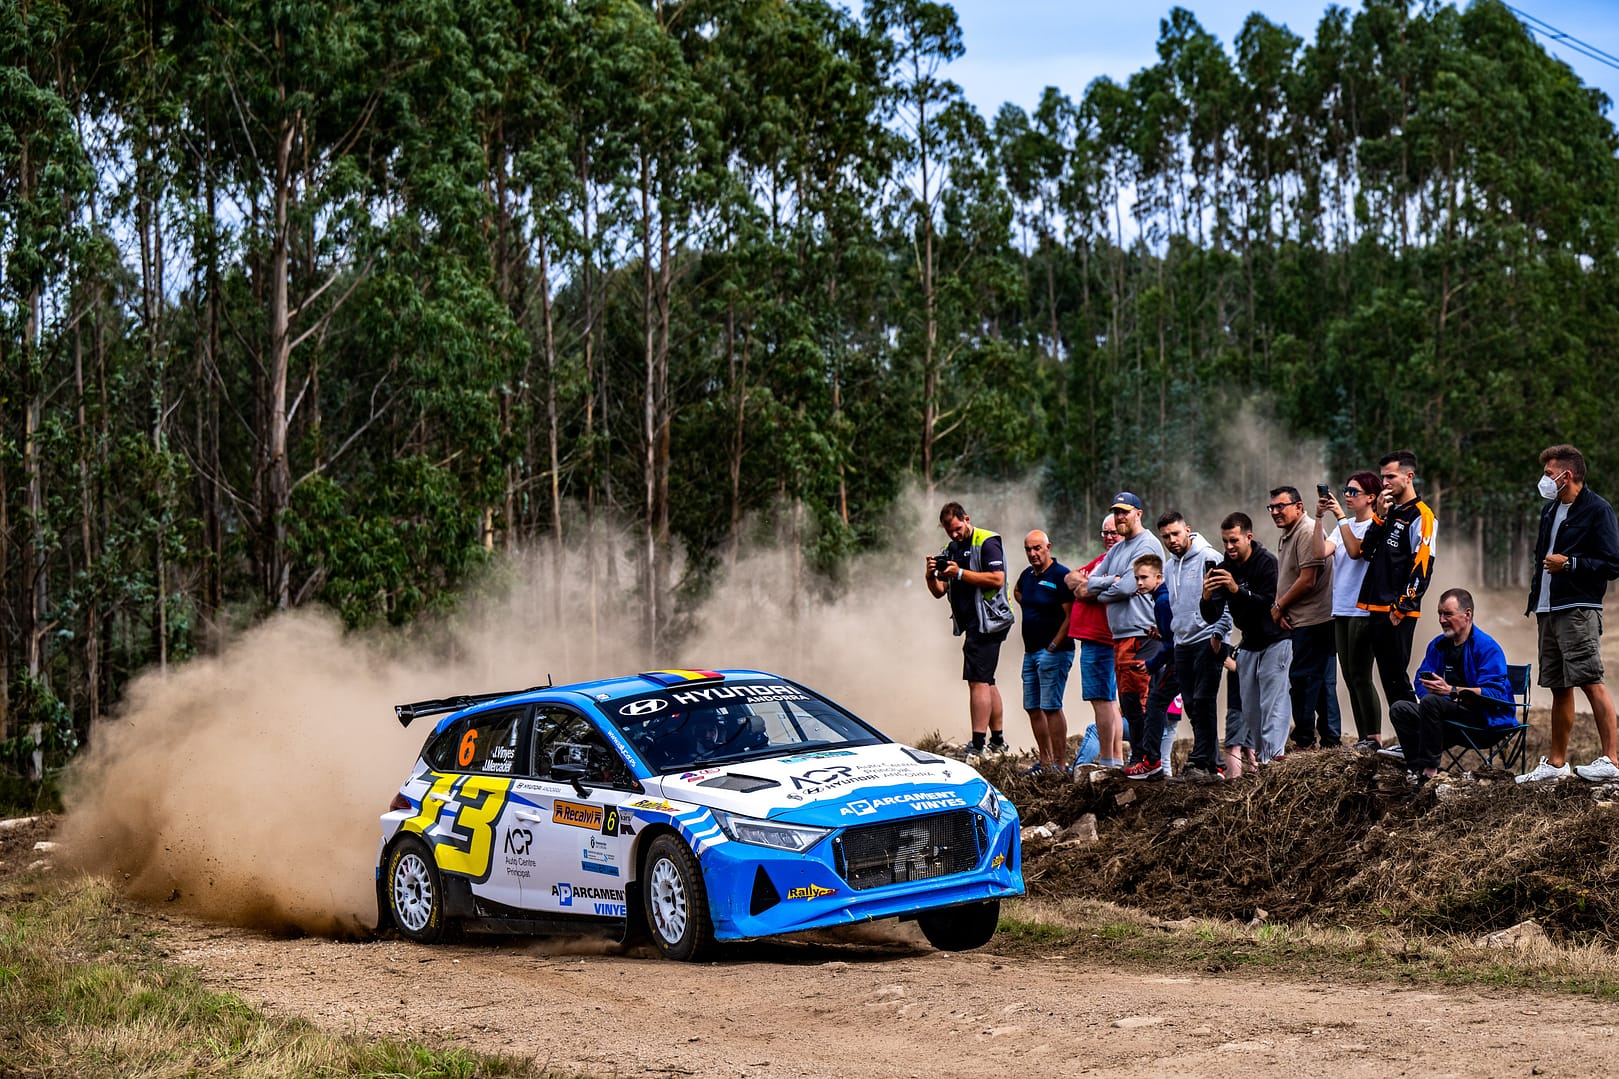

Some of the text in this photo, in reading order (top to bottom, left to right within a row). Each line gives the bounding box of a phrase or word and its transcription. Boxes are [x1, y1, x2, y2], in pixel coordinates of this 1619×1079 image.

[672, 685, 802, 705] HYUNDAI
[746, 694, 810, 703] ANDORRA
[458, 728, 479, 767] 6
[824, 775, 880, 790] HYUNDAI
[908, 798, 967, 811] VINYES
[564, 807, 594, 825] Recalvi
[607, 811, 617, 831] 6
[388, 850, 401, 910] SCORPION
[552, 883, 625, 906] APARCAMEN
[594, 903, 627, 916] VINYE
